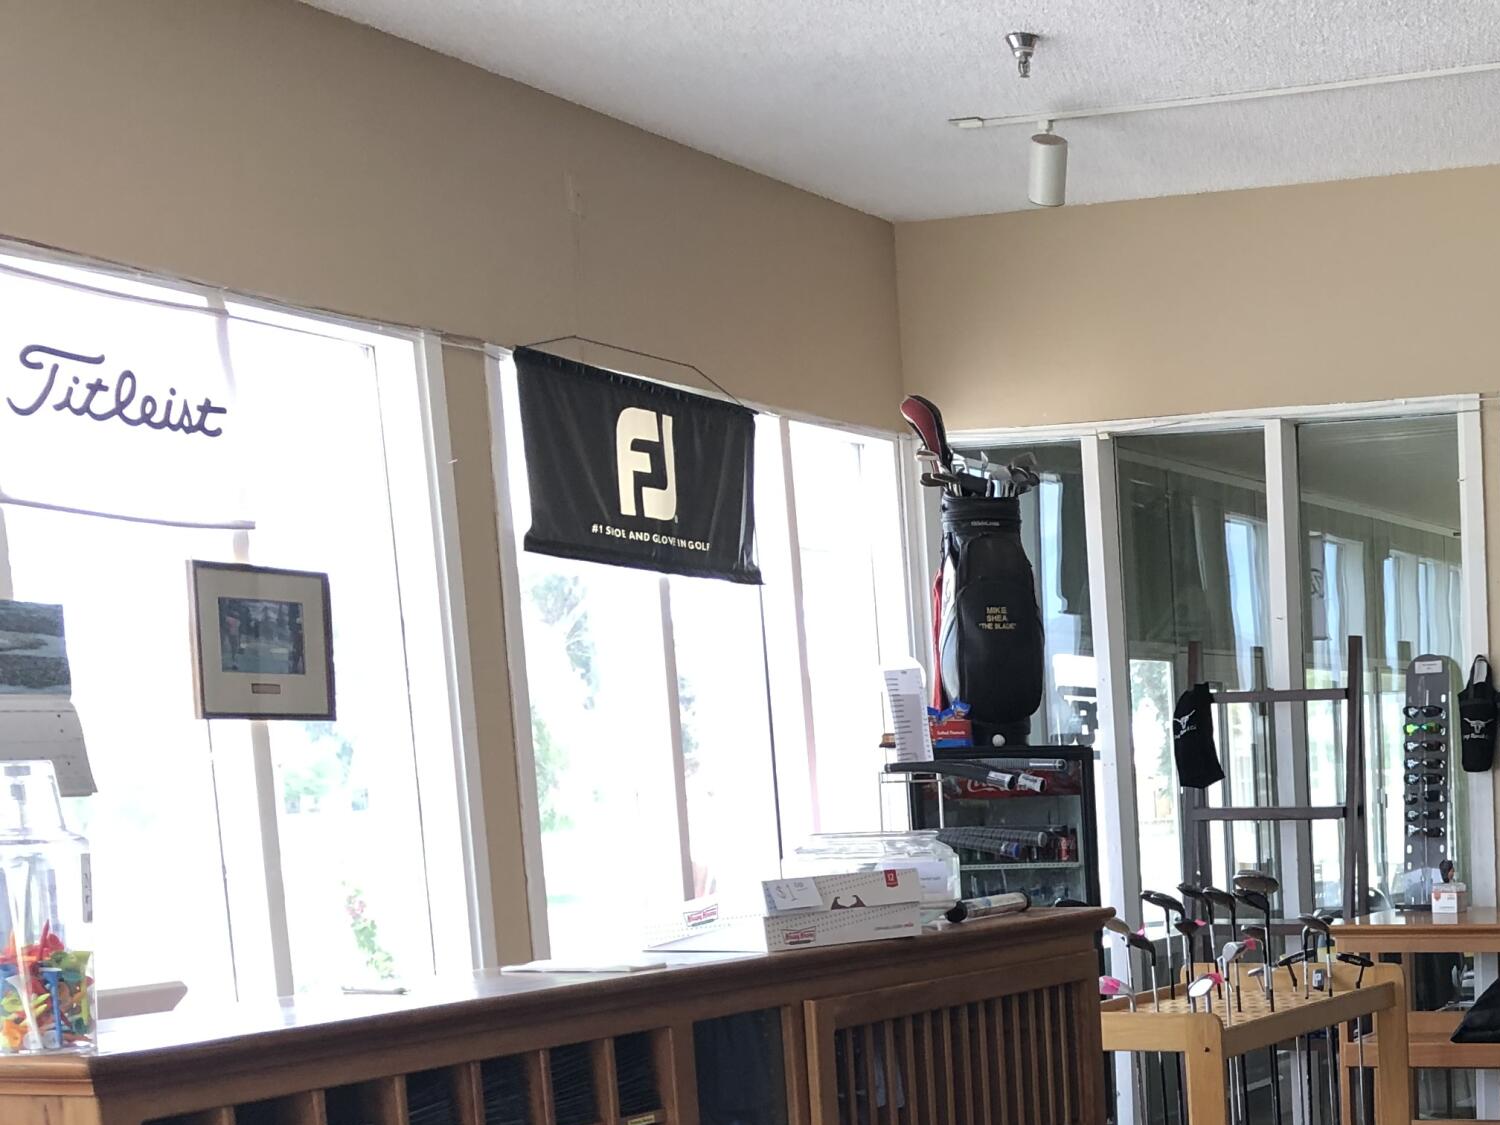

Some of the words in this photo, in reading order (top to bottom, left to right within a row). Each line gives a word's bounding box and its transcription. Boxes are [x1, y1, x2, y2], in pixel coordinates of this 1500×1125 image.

[6, 344, 227, 437] Titleist
[591, 524, 603, 534] #1
[628, 531, 650, 542] AND
[677, 539, 687, 548] IN
[986, 606, 1008, 614] MIKE
